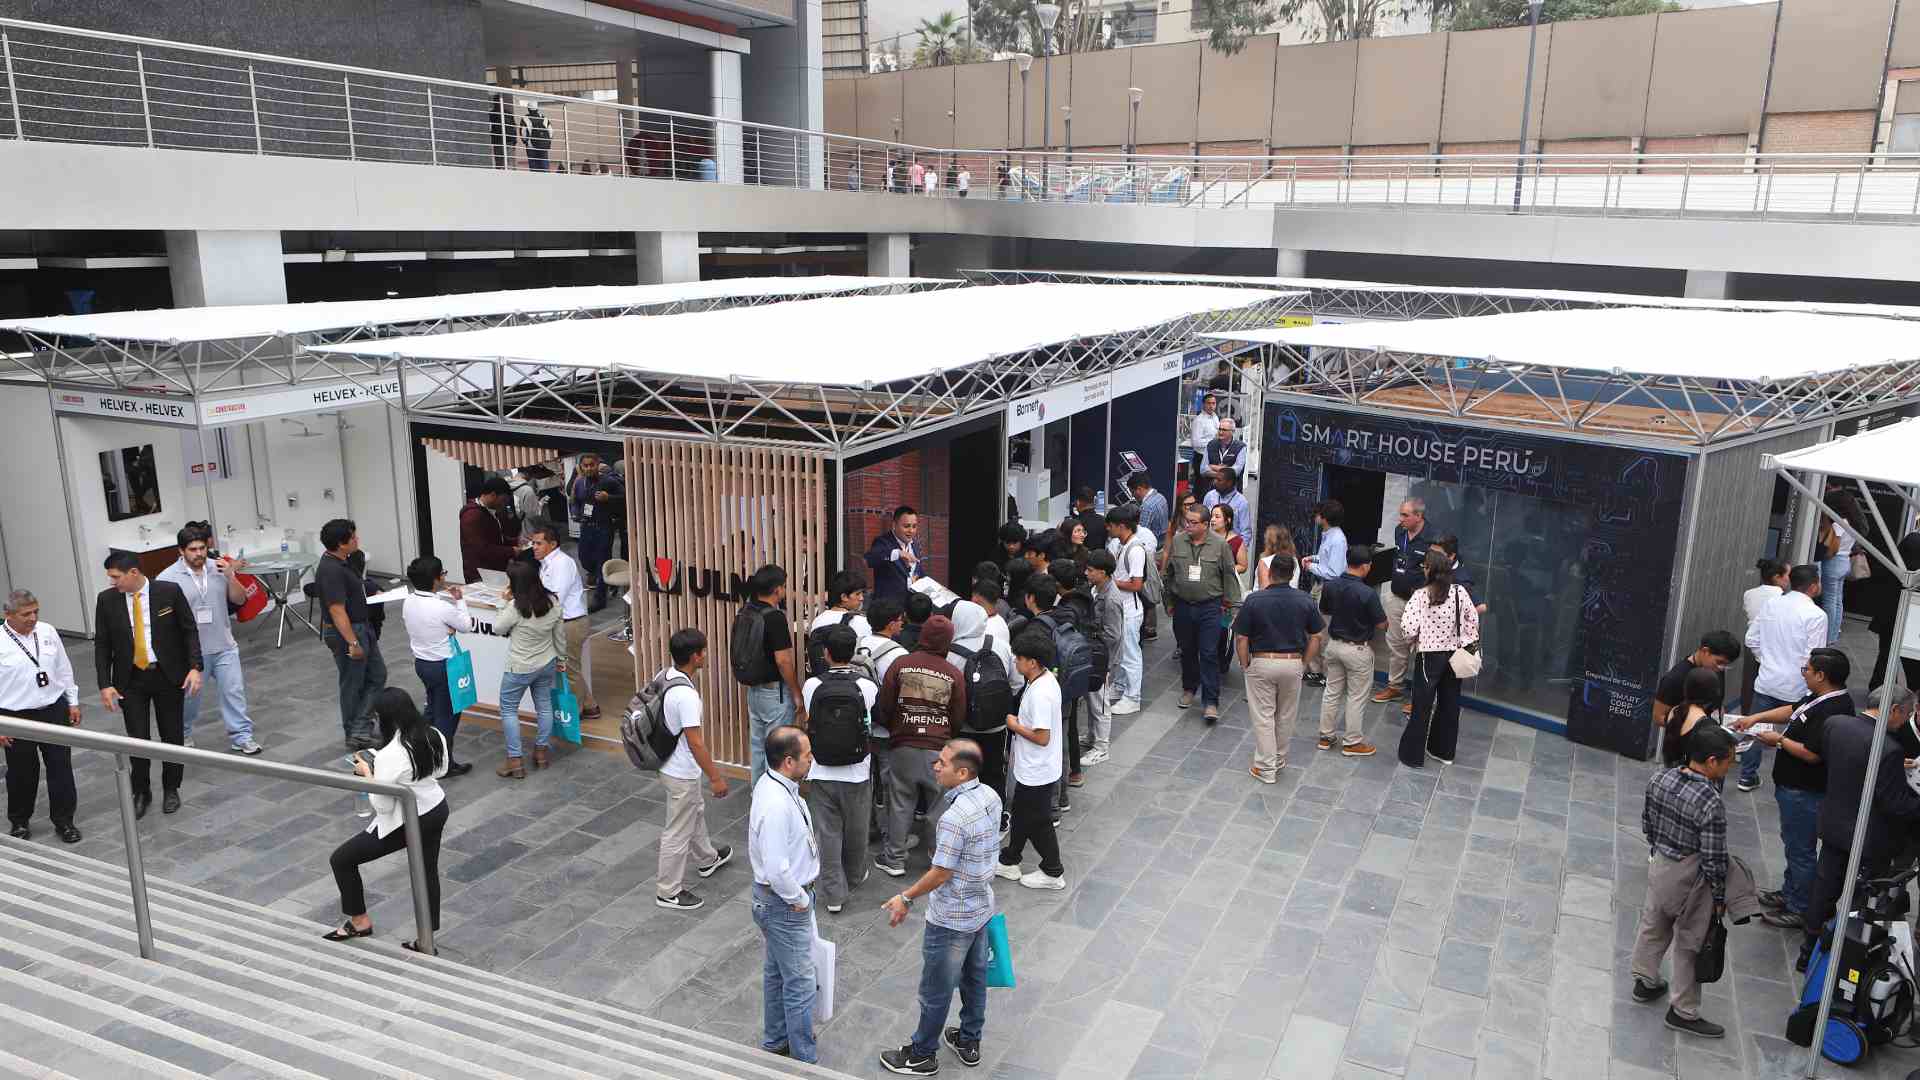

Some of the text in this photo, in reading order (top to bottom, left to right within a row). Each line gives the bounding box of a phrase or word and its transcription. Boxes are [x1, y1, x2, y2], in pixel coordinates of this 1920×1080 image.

[313, 385, 356, 404] HELVEX
[366, 382, 399, 397] HELVE
[100, 398, 137, 413] HELVEX
[145, 403, 185, 418] HELVEX
[1301, 423, 1534, 474] SMART HOUSE PERÚ
[687, 566, 756, 602] ULM
